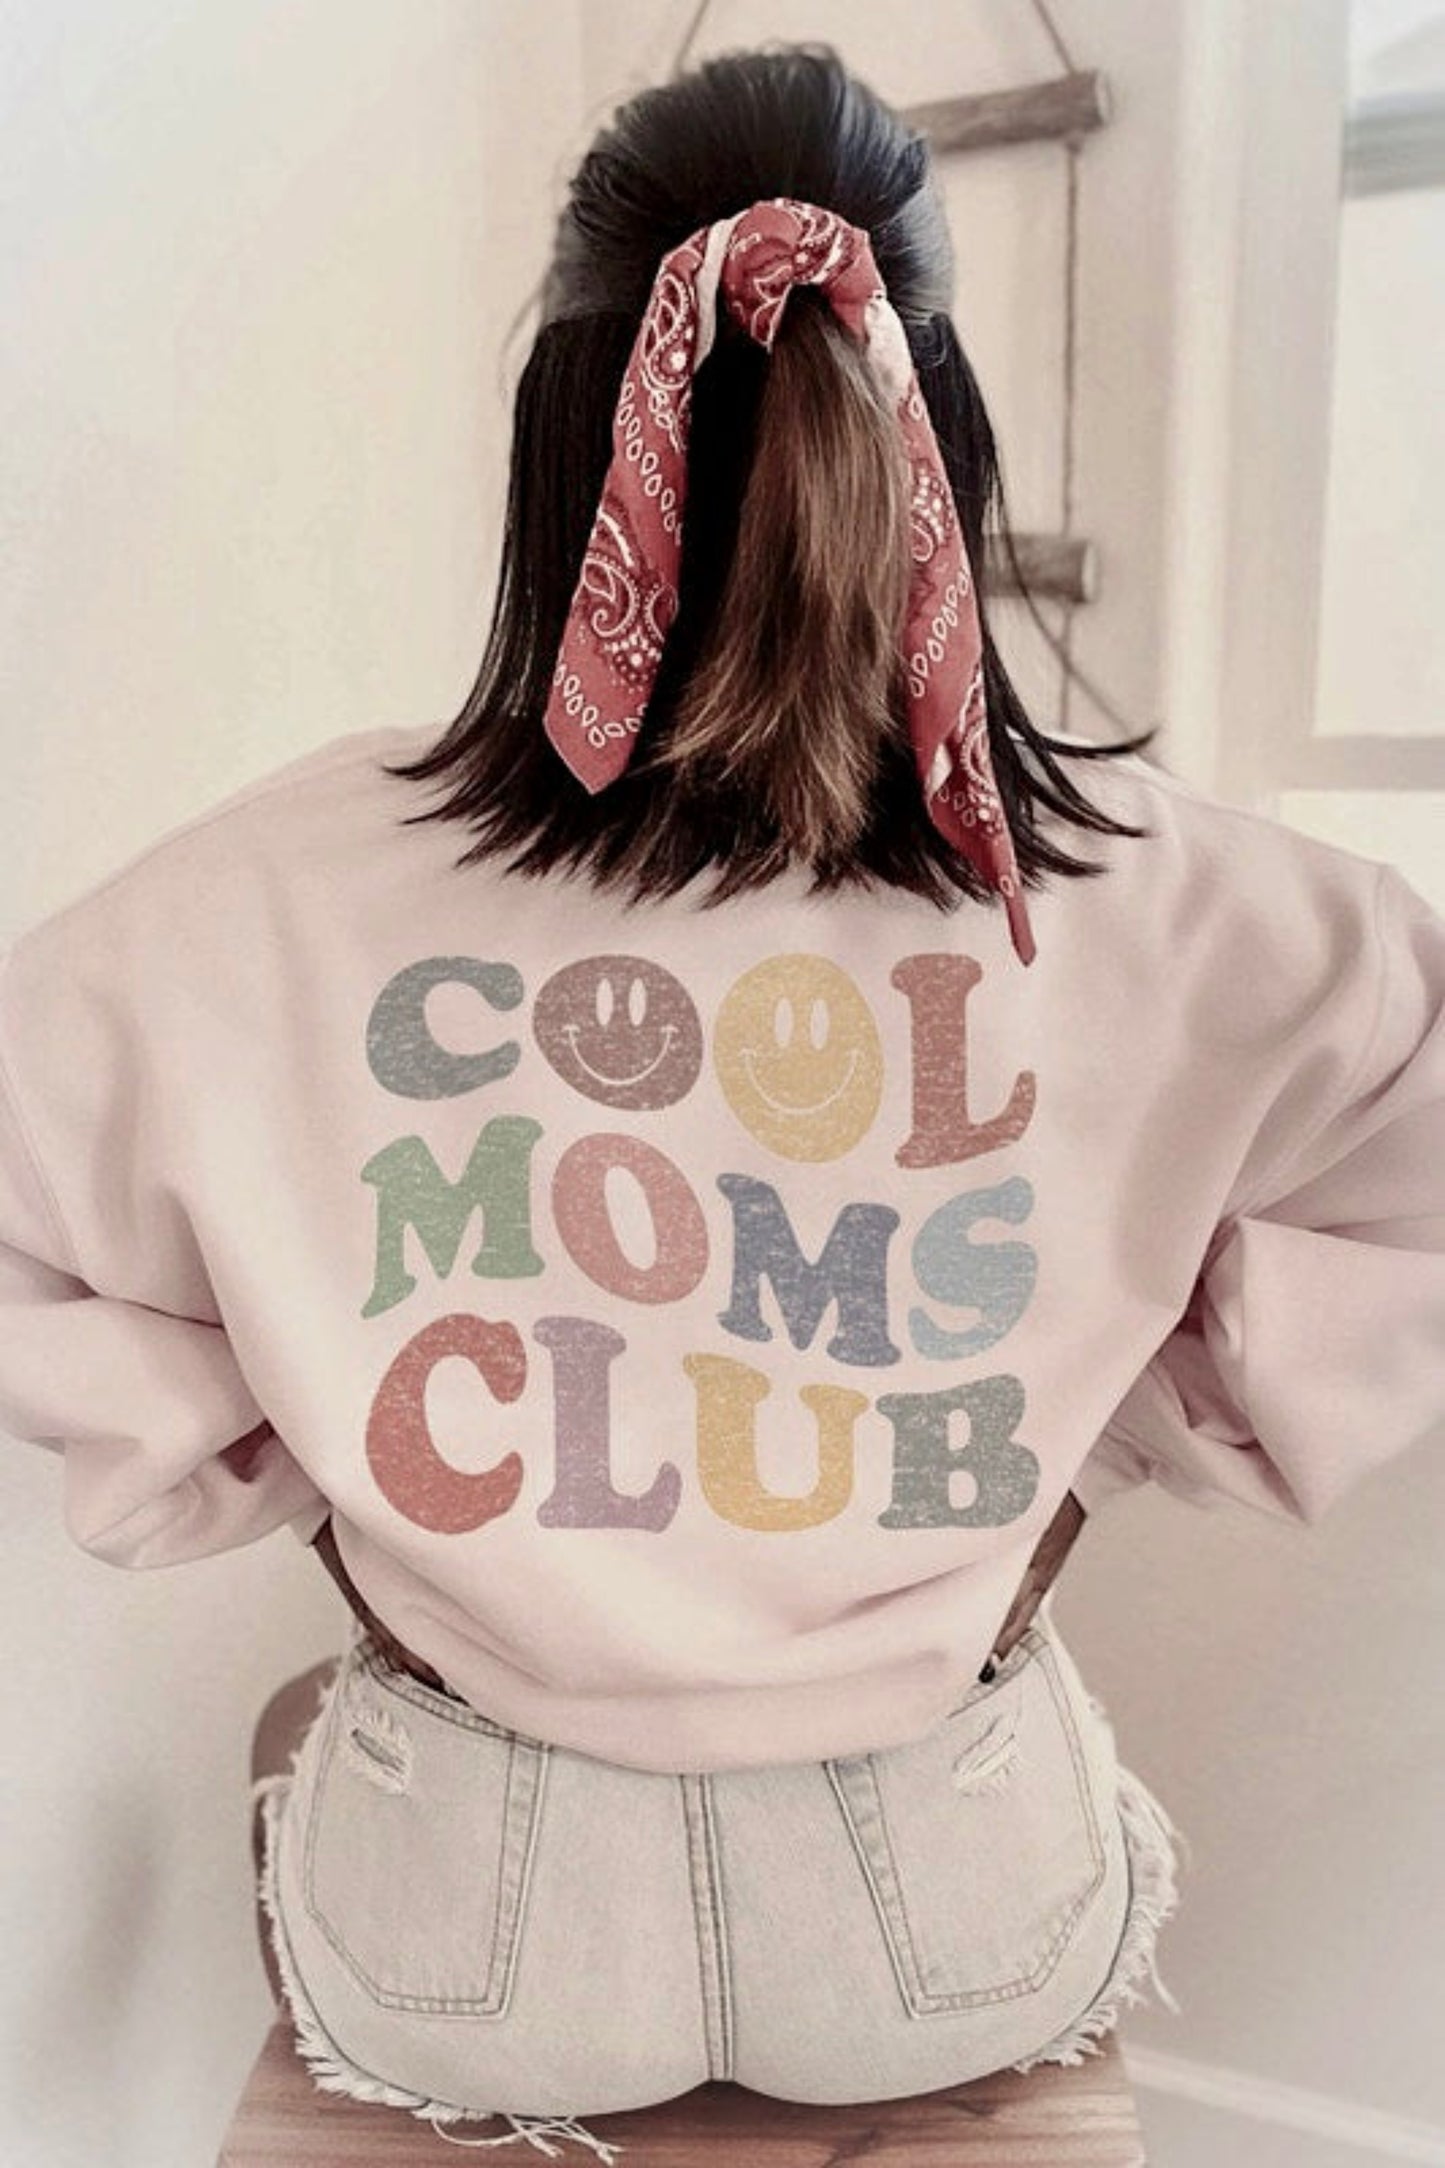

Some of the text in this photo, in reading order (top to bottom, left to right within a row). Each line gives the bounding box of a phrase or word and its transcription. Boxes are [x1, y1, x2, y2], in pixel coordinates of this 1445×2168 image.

[366, 953, 1036, 1168] COOL
[360, 1115, 1038, 1367] MOMS
[365, 1313, 1040, 1534] CLUB
